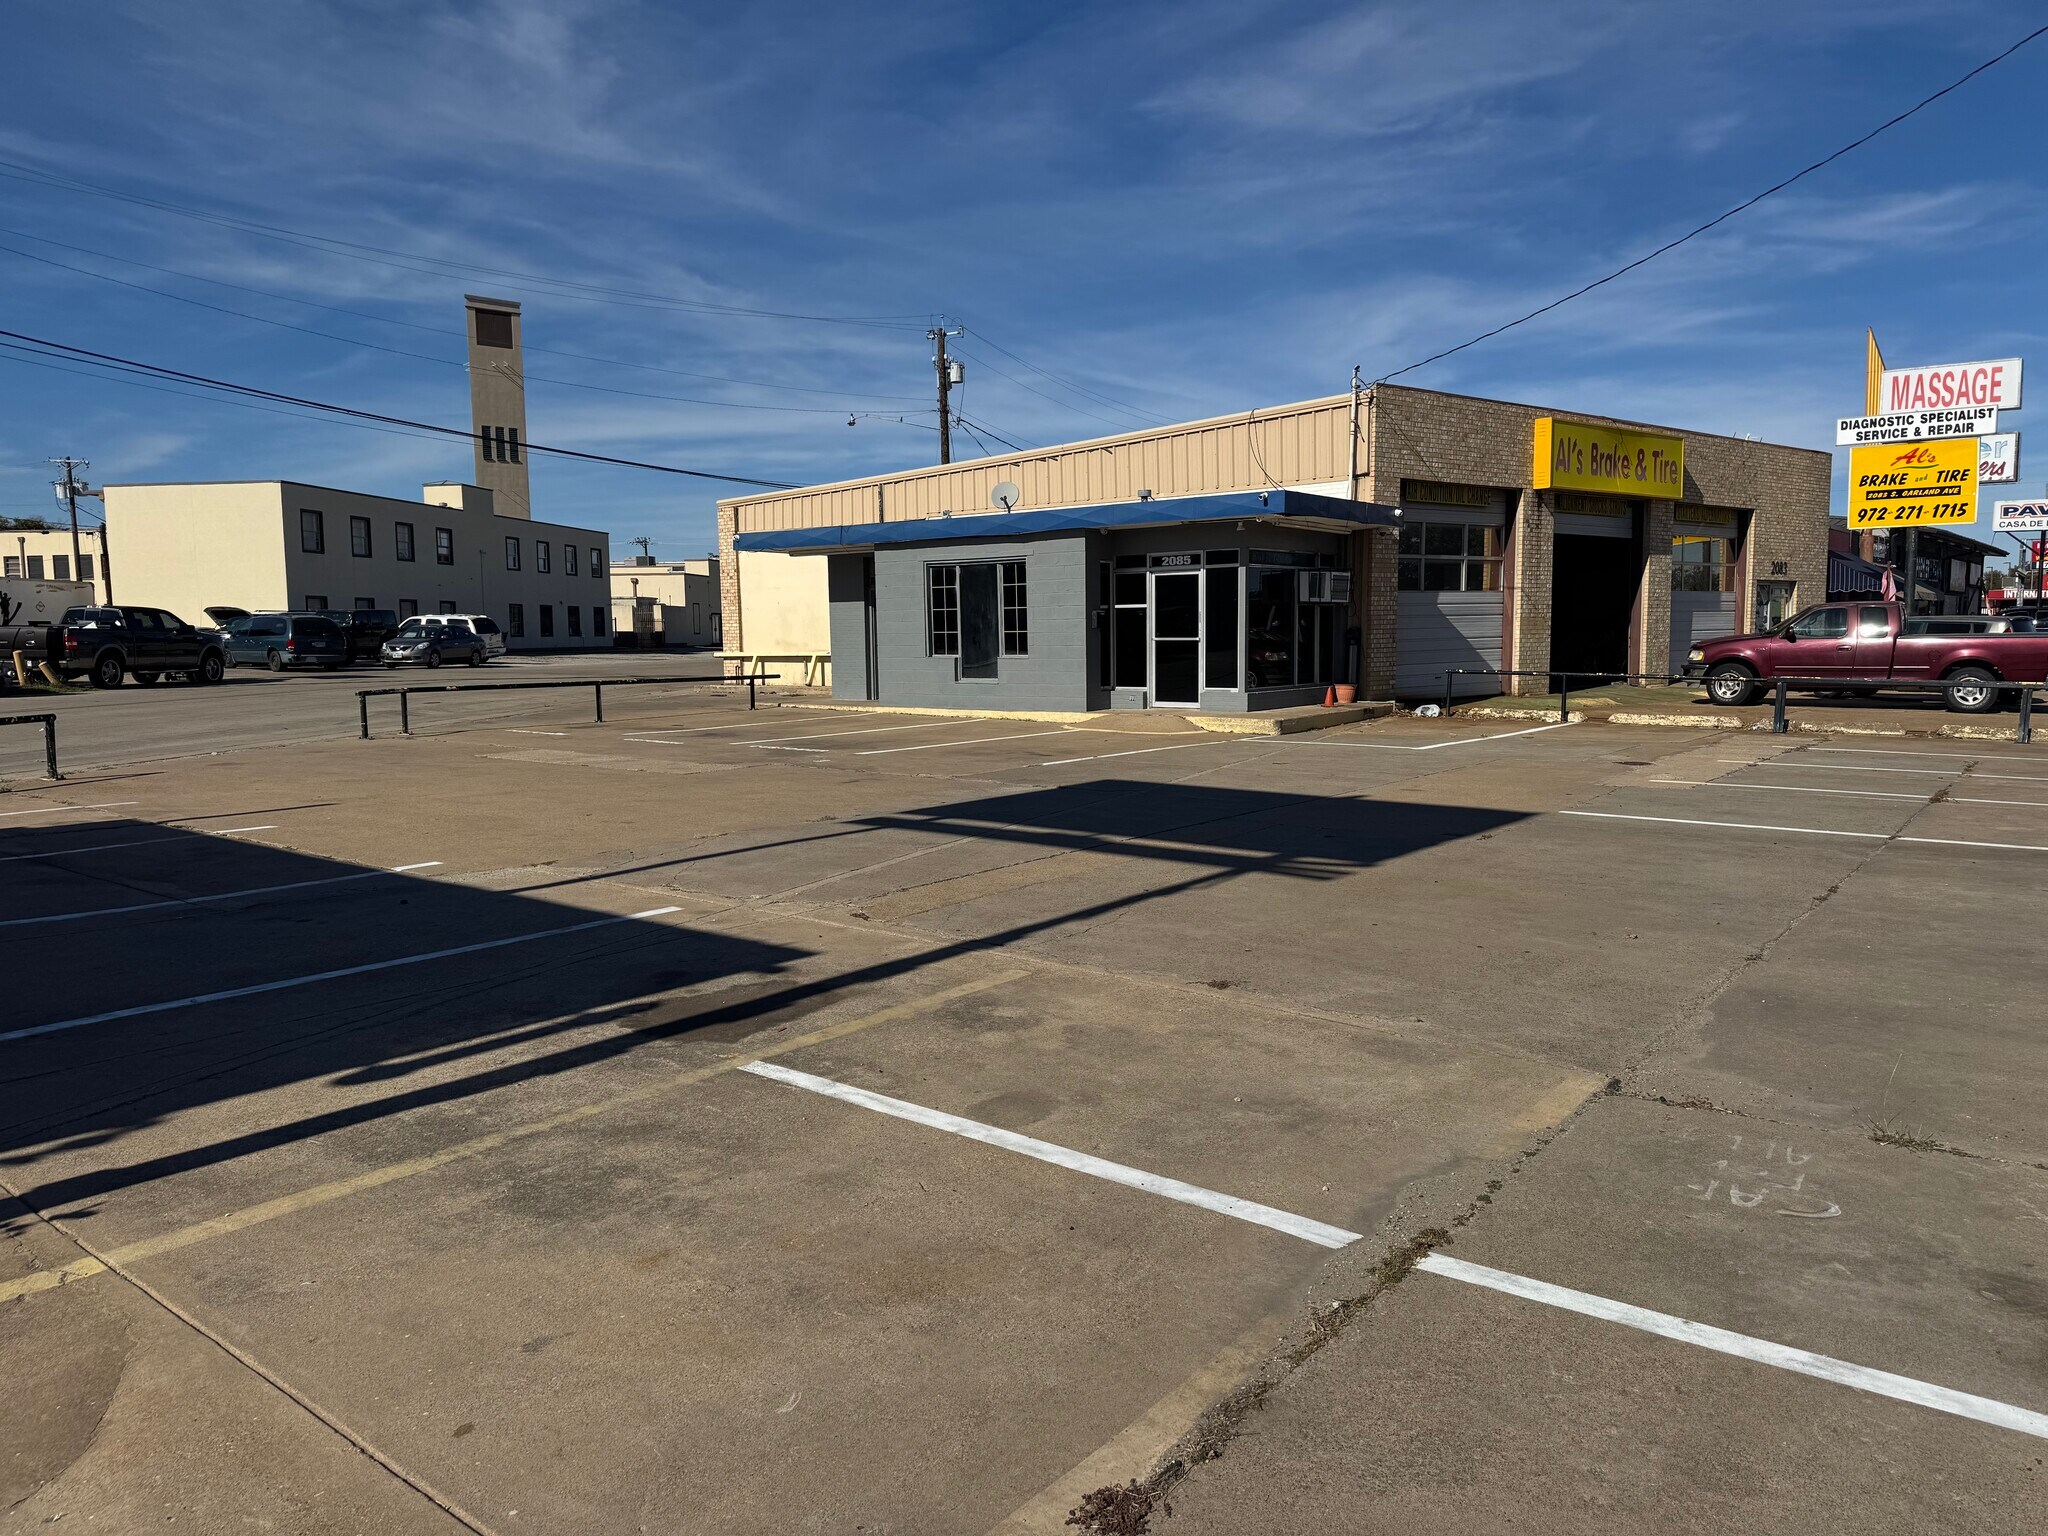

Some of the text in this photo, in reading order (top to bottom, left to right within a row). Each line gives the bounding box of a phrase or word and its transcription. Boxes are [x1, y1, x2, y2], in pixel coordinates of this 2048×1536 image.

[1890, 366, 2004, 411] MASSAGE
[1840, 408, 1994, 431] DIAGNOSTIC SPECIALIST
[1856, 422, 1974, 441] SERVICE & REPAIR
[1555, 436, 1679, 485] Al's Brake & Tire
[1890, 447, 1937, 467] Al's
[1859, 469, 1971, 487] BRAKE and TIRE
[1902, 488, 1941, 497] GARLAND
[1999, 520, 2027, 529] CASA
[2029, 519, 2044, 528] DE
[1161, 555, 1191, 566] 2085
